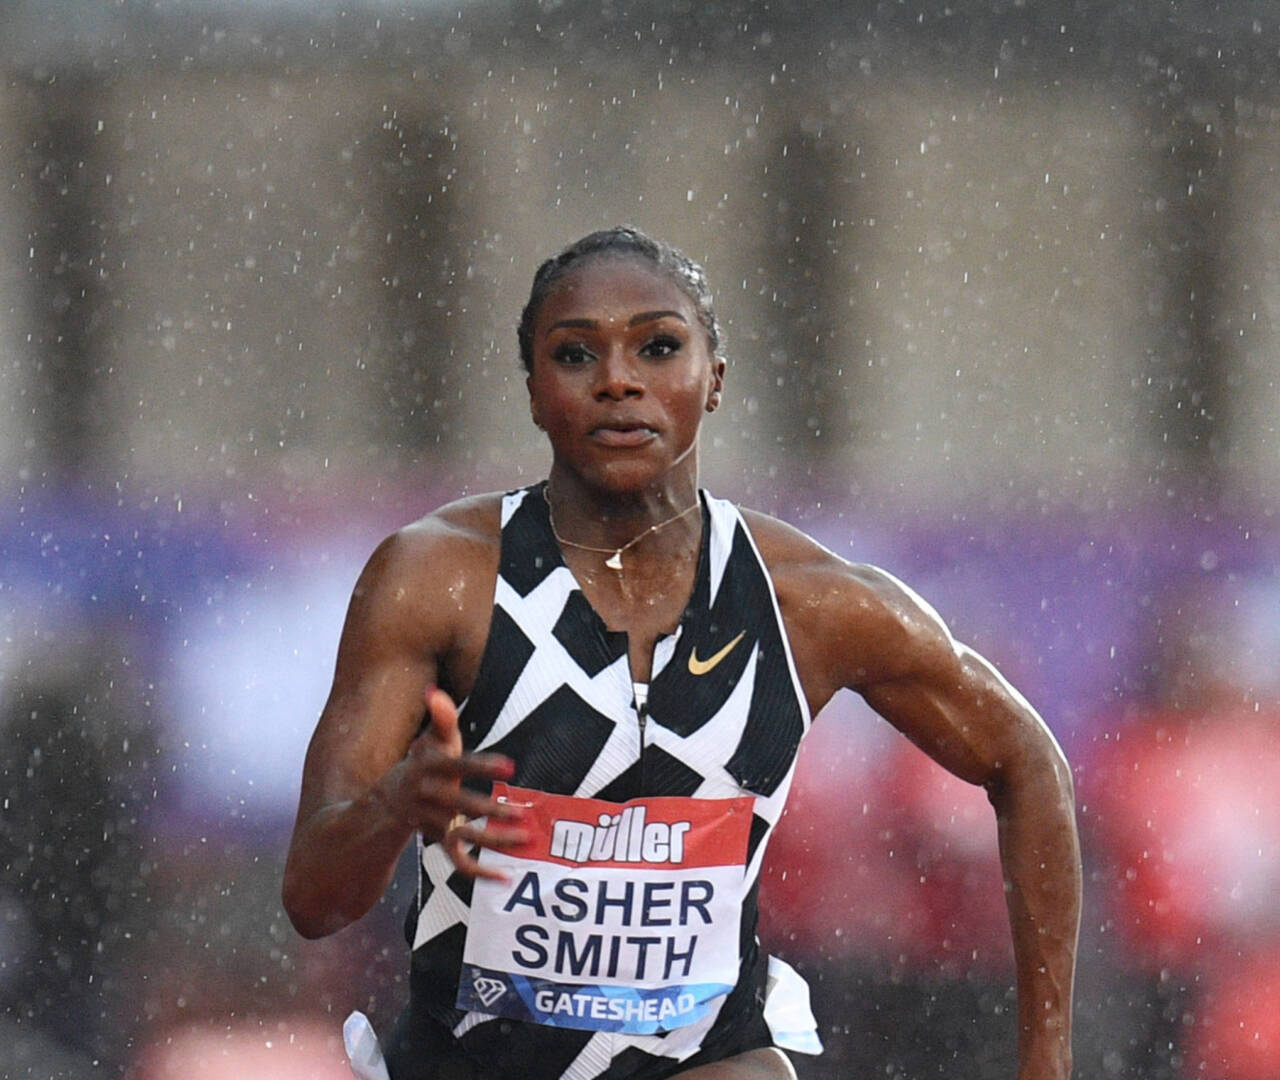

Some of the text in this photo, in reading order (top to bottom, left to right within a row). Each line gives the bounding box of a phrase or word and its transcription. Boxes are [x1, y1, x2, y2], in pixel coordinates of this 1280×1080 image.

[550, 805, 691, 863] müller
[503, 871, 715, 928] ASHER
[512, 924, 698, 980] SMITH
[534, 990, 696, 1021] GATESHEAD
